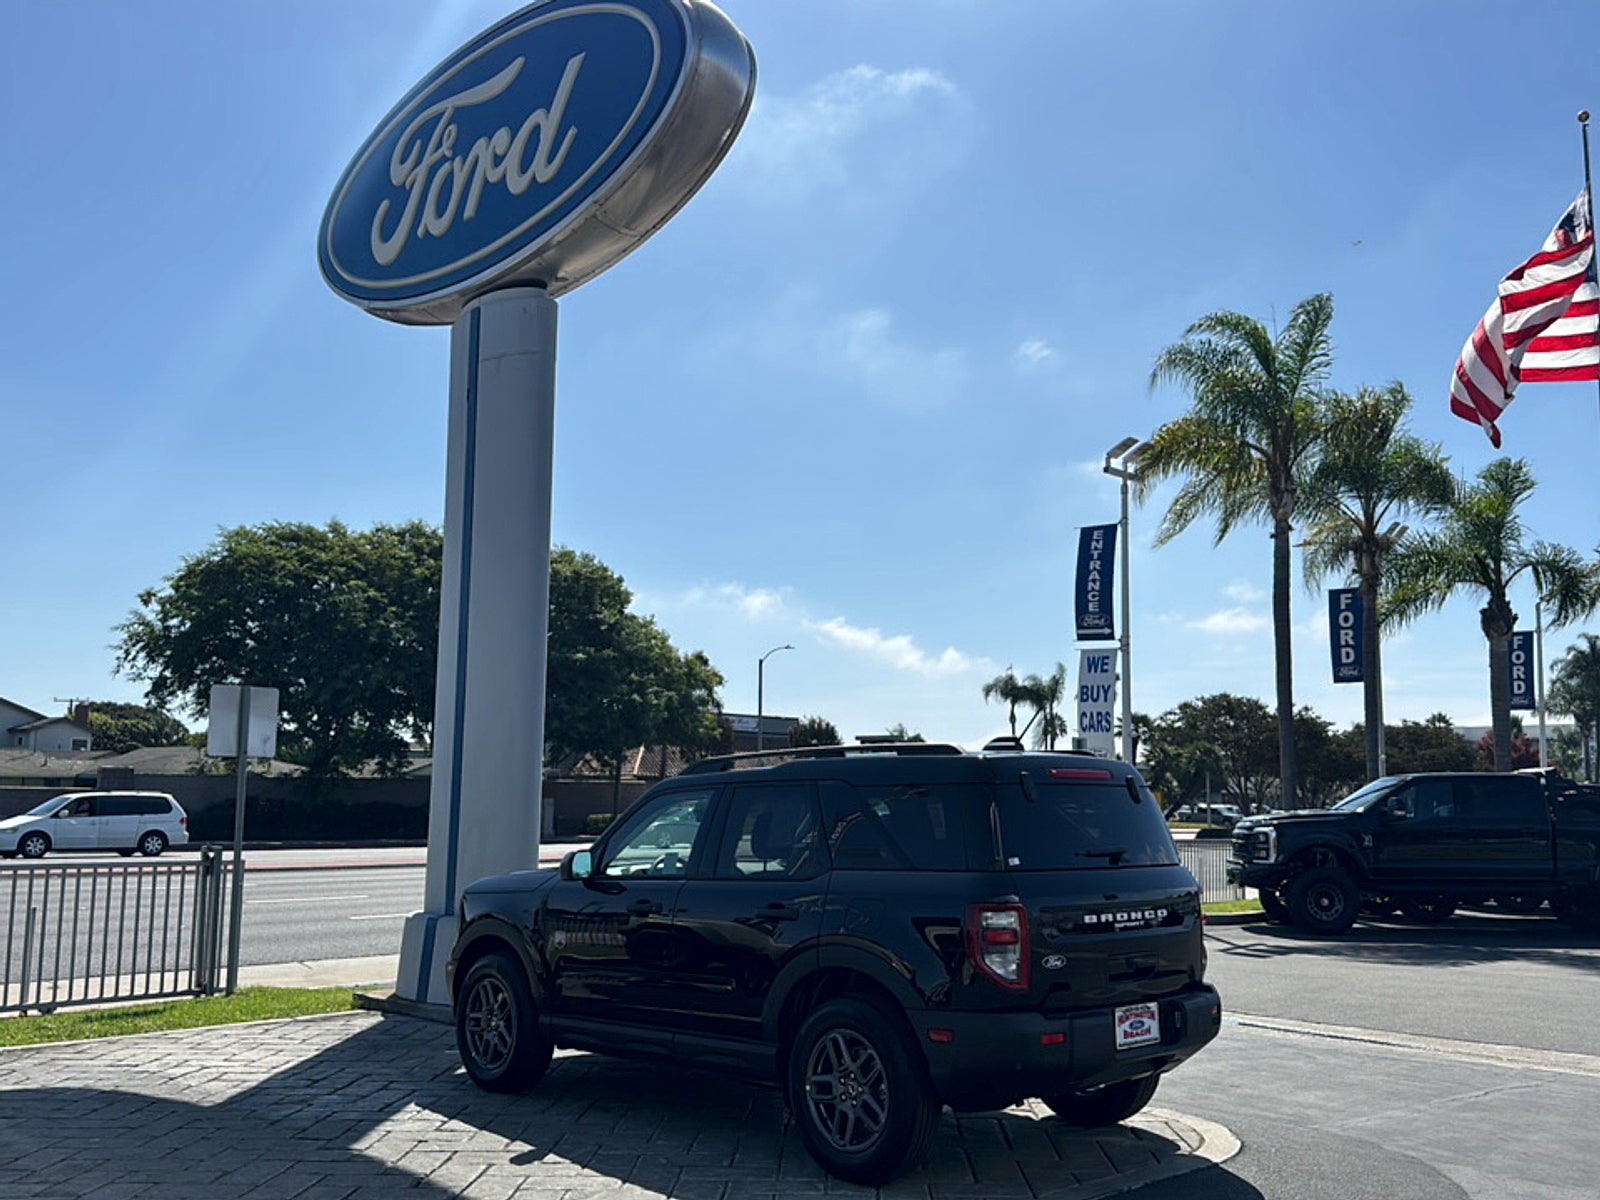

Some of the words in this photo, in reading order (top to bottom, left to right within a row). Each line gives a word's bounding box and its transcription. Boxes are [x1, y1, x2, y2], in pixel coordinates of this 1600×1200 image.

[371, 52, 586, 266] Ford
[1087, 529, 1103, 612] ENTRANCE
[1338, 593, 1355, 664] FORD
[1086, 655, 1109, 674] WE
[1511, 635, 1526, 694] FORD
[1080, 684, 1111, 703] BUY
[1080, 711, 1111, 733] CARS
[1083, 908, 1168, 923] BRONCO
